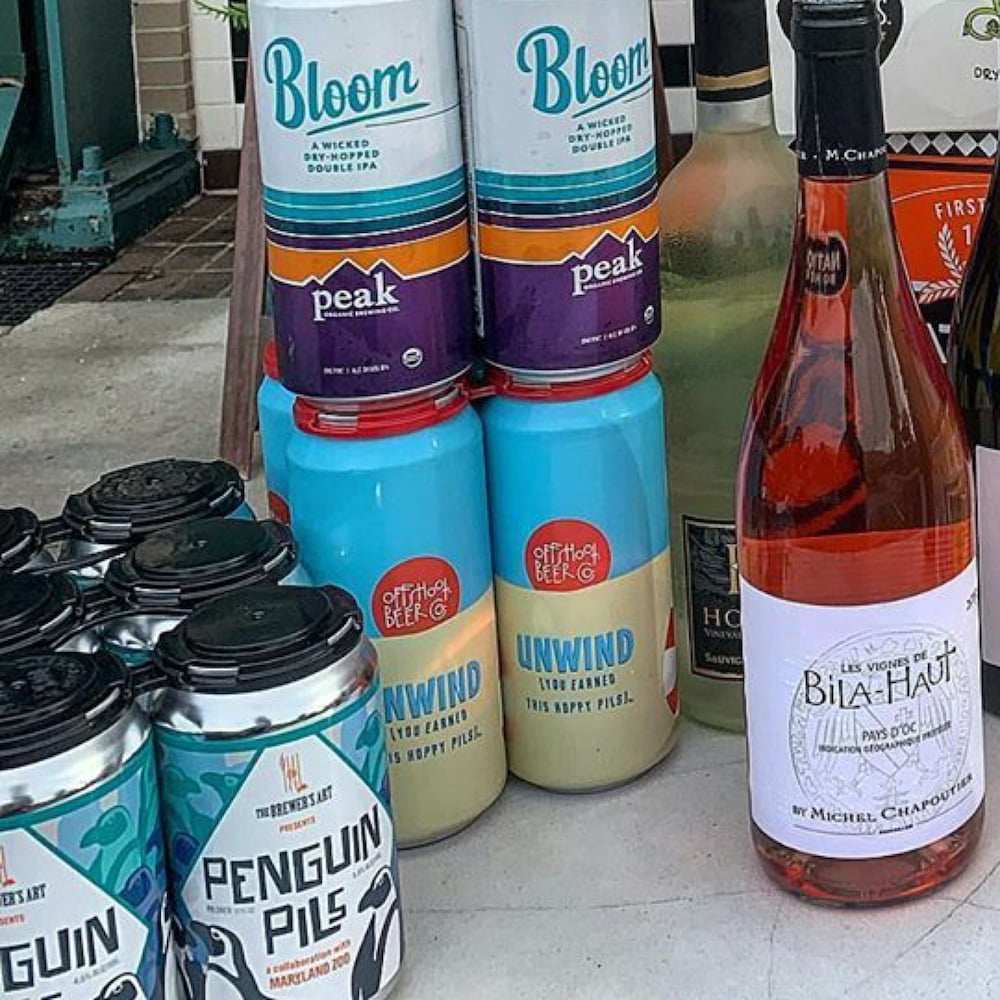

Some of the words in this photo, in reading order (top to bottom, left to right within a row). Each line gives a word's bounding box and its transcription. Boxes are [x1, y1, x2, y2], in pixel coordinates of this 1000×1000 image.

[516, 24, 650, 115] Bloom
[264, 36, 419, 129] Bloom
[567, 122, 633, 145] DRY-HOPPED
[587, 114, 627, 130] WICKED
[303, 149, 380, 162] DRY-HOPPED
[320, 139, 370, 149] WICKED
[571, 139, 613, 155] DOUBLE
[307, 162, 354, 173] DOUBLE
[357, 161, 378, 171] IPA
[570, 238, 644, 297] peak
[310, 271, 400, 322] peak
[516, 628, 635, 673] UNWIND
[840, 662, 862, 674] LES
[867, 656, 910, 673] VIGNES
[913, 650, 929, 663] DE
[383, 659, 482, 724] NWIND
[571, 672, 616, 690] EARNED
[526, 697, 550, 714] THIS
[554, 699, 592, 714] HOPPY
[425, 708, 468, 735] EARNED
[861, 727, 889, 742] PAYS
[890, 721, 917, 737] D'OC
[316, 784, 333, 803] ART
[810, 806, 877, 823] MICHEL
[880, 772, 974, 821] CHAPOUTIER
[203, 804, 382, 905] PENGUIN
[26, 883, 47, 902] ART
[262, 885, 348, 956] PILS
[0, 906, 120, 993] GUIN
[269, 961, 331, 990] MARYLAND
